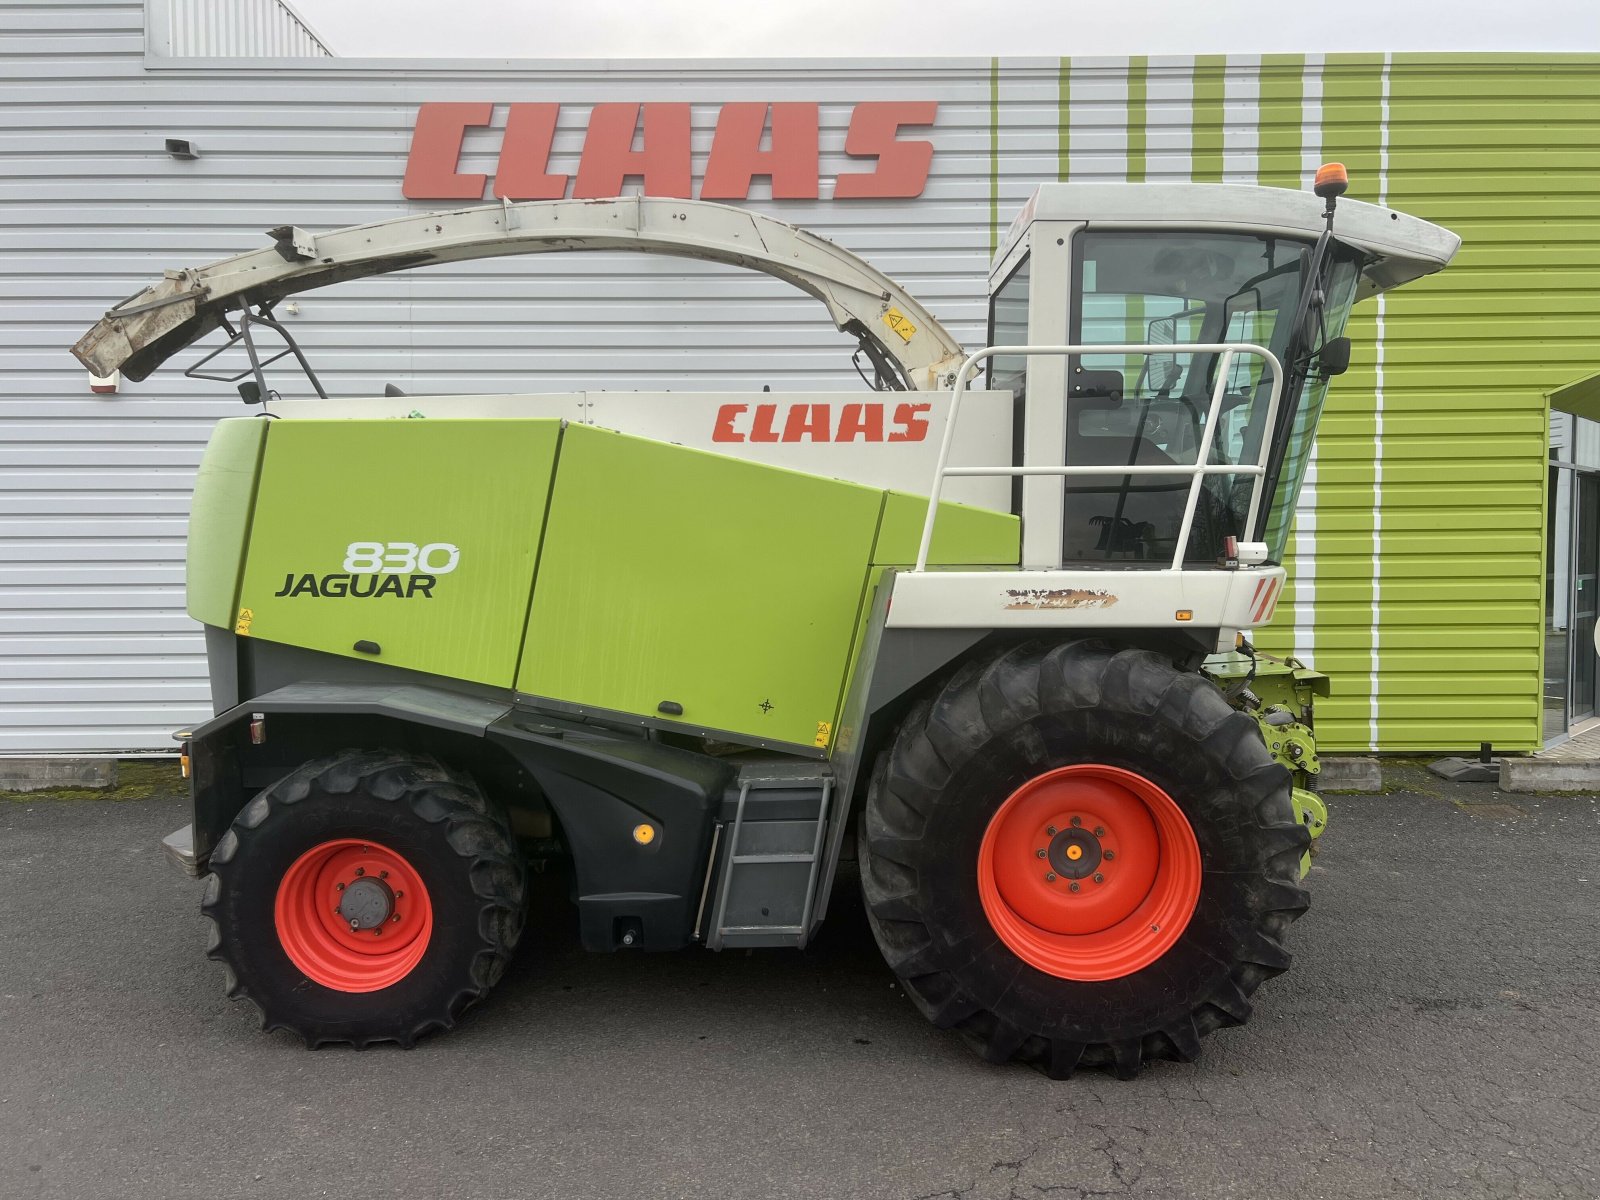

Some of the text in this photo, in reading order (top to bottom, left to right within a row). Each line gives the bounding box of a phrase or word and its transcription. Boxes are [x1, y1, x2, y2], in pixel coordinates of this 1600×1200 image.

[402, 102, 938, 200] CLAAS
[712, 403, 931, 443] CLAAS
[343, 542, 460, 574] 830
[274, 573, 437, 598] JAGUAR
